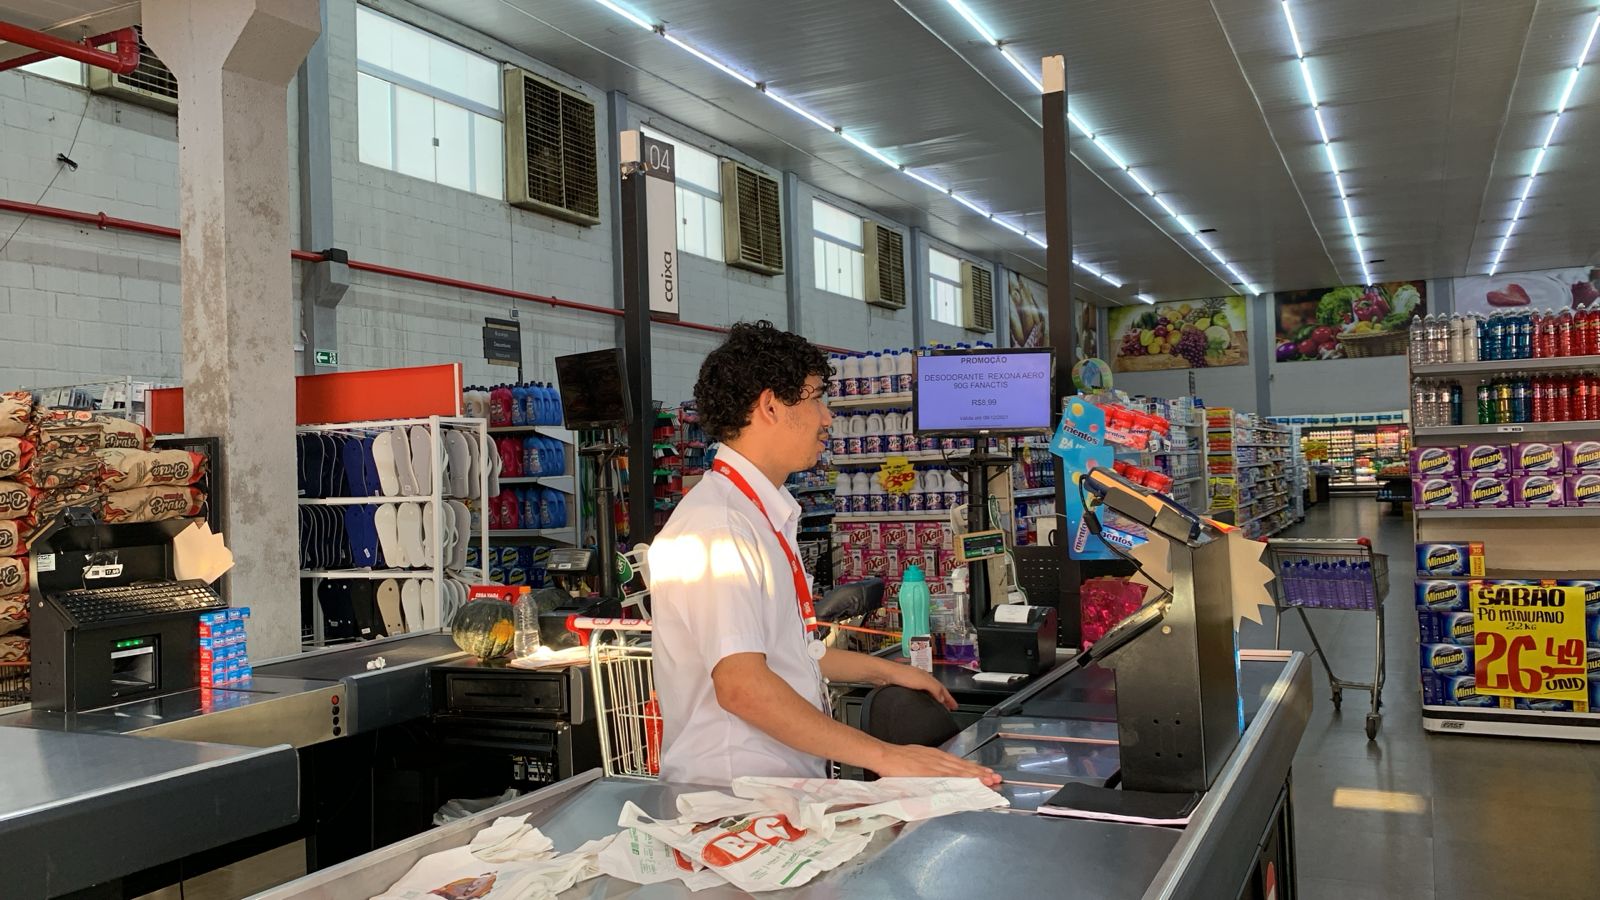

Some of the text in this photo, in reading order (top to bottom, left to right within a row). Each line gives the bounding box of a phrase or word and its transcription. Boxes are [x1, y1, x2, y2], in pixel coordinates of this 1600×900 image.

[650, 145, 671, 173] 04
[661, 251, 674, 303] caixa
[960, 355, 1008, 365] PROMOÇÃO
[924, 371, 1045, 382] DESODORANTE REXONA AERO
[953, 381, 1008, 390] 90G FANACTIS
[105, 433, 140, 448] Brasa
[1063, 424, 1098, 445] mentos
[1420, 454, 1451, 470] Minuano
[1469, 452, 1502, 468] Minuano
[1521, 450, 1554, 465] Minuano
[1574, 451, 1600, 464] Minua
[152, 462, 188, 479] Brasa
[1423, 486, 1453, 501] Minuano
[1471, 484, 1504, 499] Minuano
[1523, 482, 1556, 498] Minuano
[1575, 482, 1600, 498] Minua
[0, 489, 28, 510] Bra
[149, 496, 187, 515] Brasa
[1075, 523, 1088, 551] mento
[1427, 552, 1460, 567] Minuano
[1425, 588, 1458, 602] Minuano
[1478, 585, 1565, 607] SABÃO
[1453, 622, 1474, 635] Minu
[1432, 652, 1465, 667] Minuano
[1455, 686, 1476, 698] Minu
[711, 815, 792, 859] BIG
